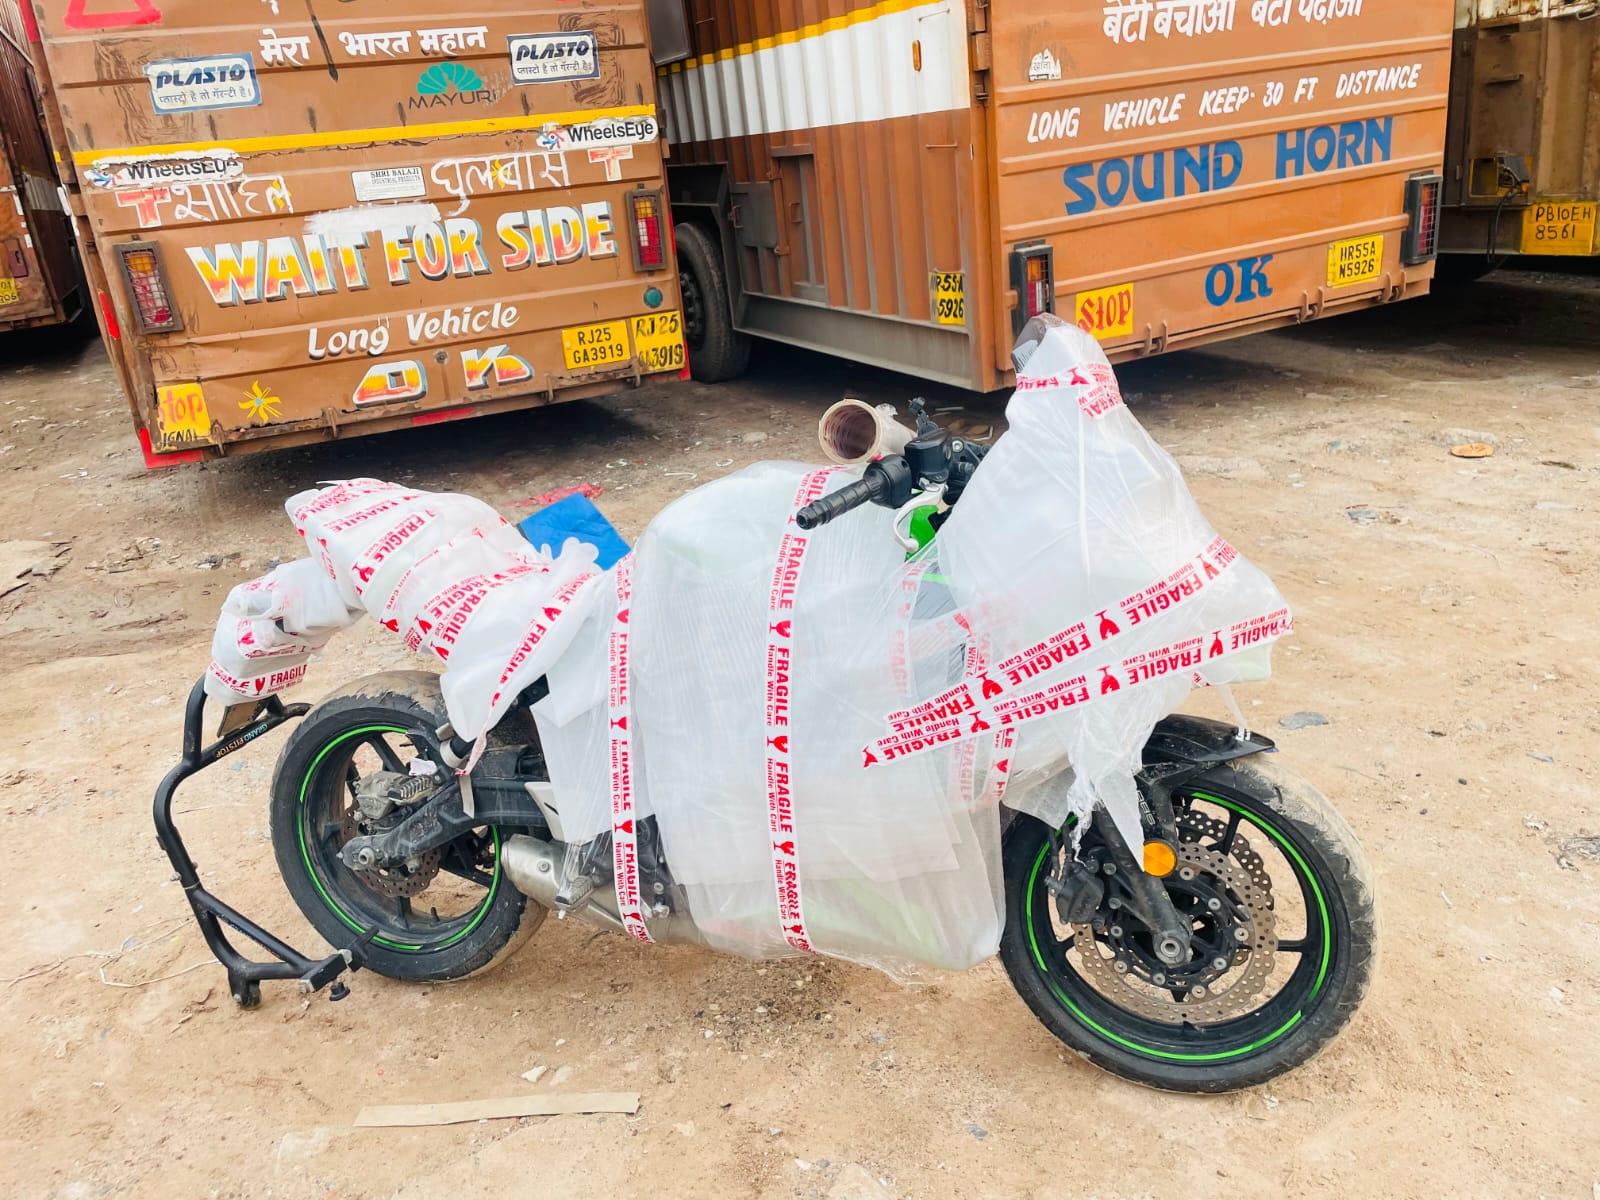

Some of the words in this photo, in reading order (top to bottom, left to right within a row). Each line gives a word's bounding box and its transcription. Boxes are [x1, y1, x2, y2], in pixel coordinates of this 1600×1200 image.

[258, 28, 311, 67] मेरा
[339, 31, 412, 58] भारत
[416, 26, 489, 56] महान
[516, 40, 590, 61] PLASTO
[156, 63, 246, 89] PLASTO
[408, 89, 497, 110] MAYURI
[1026, 107, 1081, 144] LONG
[1103, 93, 1186, 132] VEHICLE
[1262, 82, 1284, 106] 30
[1294, 77, 1319, 102] FT
[1336, 64, 1422, 98] DISTANCE
[567, 120, 654, 142] WheelsEye
[1062, 139, 1243, 216] SOUND
[1275, 116, 1393, 180] HORN
[1536, 223, 1576, 240] 8561
[185, 232, 369, 308] WAIT
[381, 217, 491, 285] FOR
[497, 200, 618, 272] SIDE
[1339, 259, 1375, 279] N5926
[1206, 254, 1273, 307] OK
[308, 325, 390, 360] Long
[407, 302, 520, 344] Vehicle
[578, 327, 611, 345] RJ25
[573, 343, 623, 364] GA3919
[779, 537, 807, 609] FRAGILE
[1126, 572, 1205, 626] FRAGILE
[442, 589, 488, 645] FRAGILE
[1049, 622, 1086, 645] Handle
[1173, 636, 1203, 650] Handle
[1006, 633, 1092, 686] FRAGILE
[1023, 642, 1048, 657] With
[1121, 653, 1146, 666] Care
[1149, 646, 1171, 660] With
[998, 655, 1022, 670] Care
[1128, 648, 1202, 685] FRAGILE
[775, 647, 790, 727] FRAGILE
[934, 683, 968, 703] Handle
[1047, 675, 1087, 694] Handle
[911, 701, 935, 715] With
[993, 701, 1018, 713] Care
[1001, 687, 1090, 725] FRAGILE
[1019, 691, 1045, 705] With
[901, 728, 924, 741] With
[925, 718, 960, 733] Handle
[877, 735, 900, 747] Care
[776, 761, 793, 833] FRAGILE
